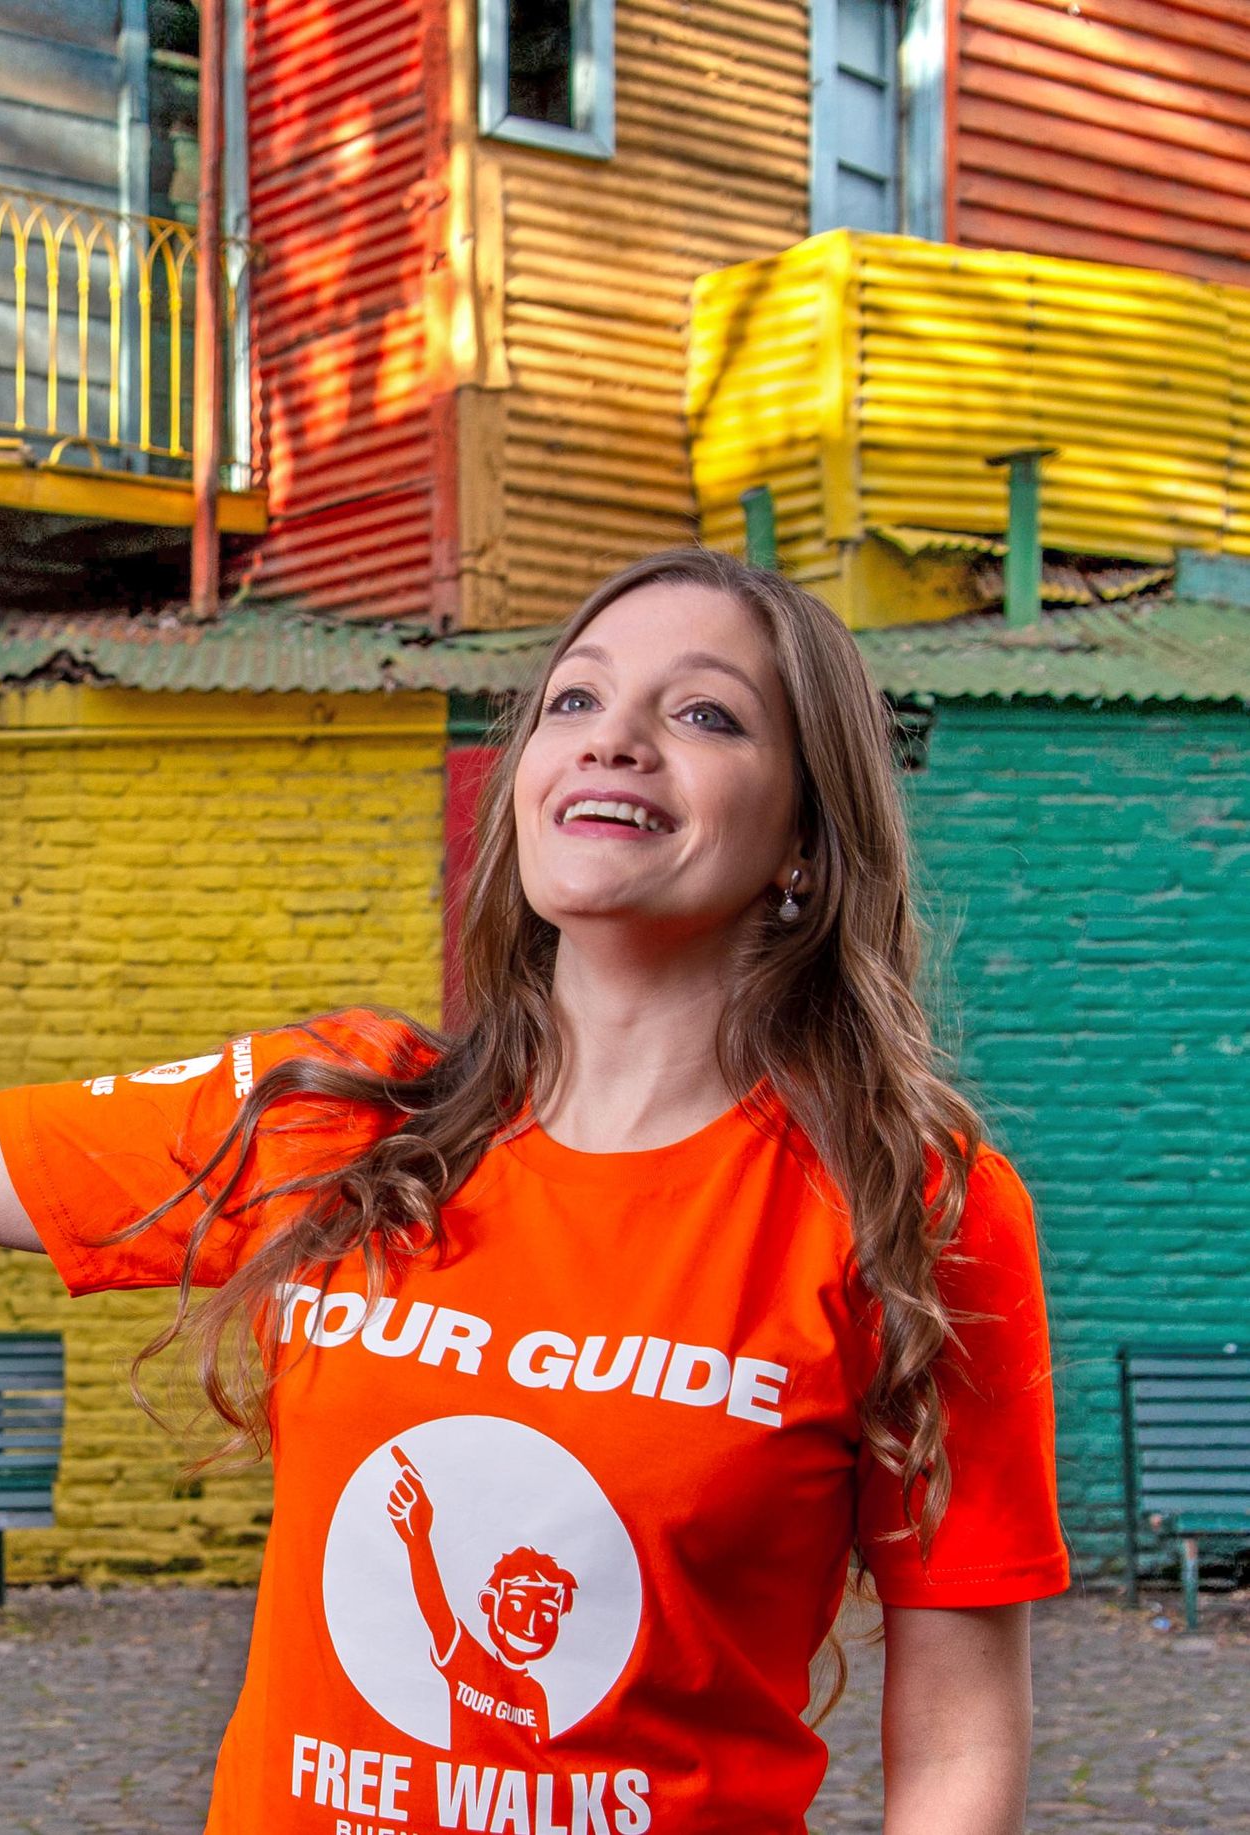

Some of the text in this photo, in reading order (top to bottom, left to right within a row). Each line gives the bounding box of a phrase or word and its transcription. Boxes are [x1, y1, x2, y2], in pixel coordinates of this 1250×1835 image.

[275, 1282, 788, 1428] TOUR GUIDE
[456, 1680, 537, 1728] TOUR GUIDE
[291, 1733, 651, 1835] FREE WALKS
